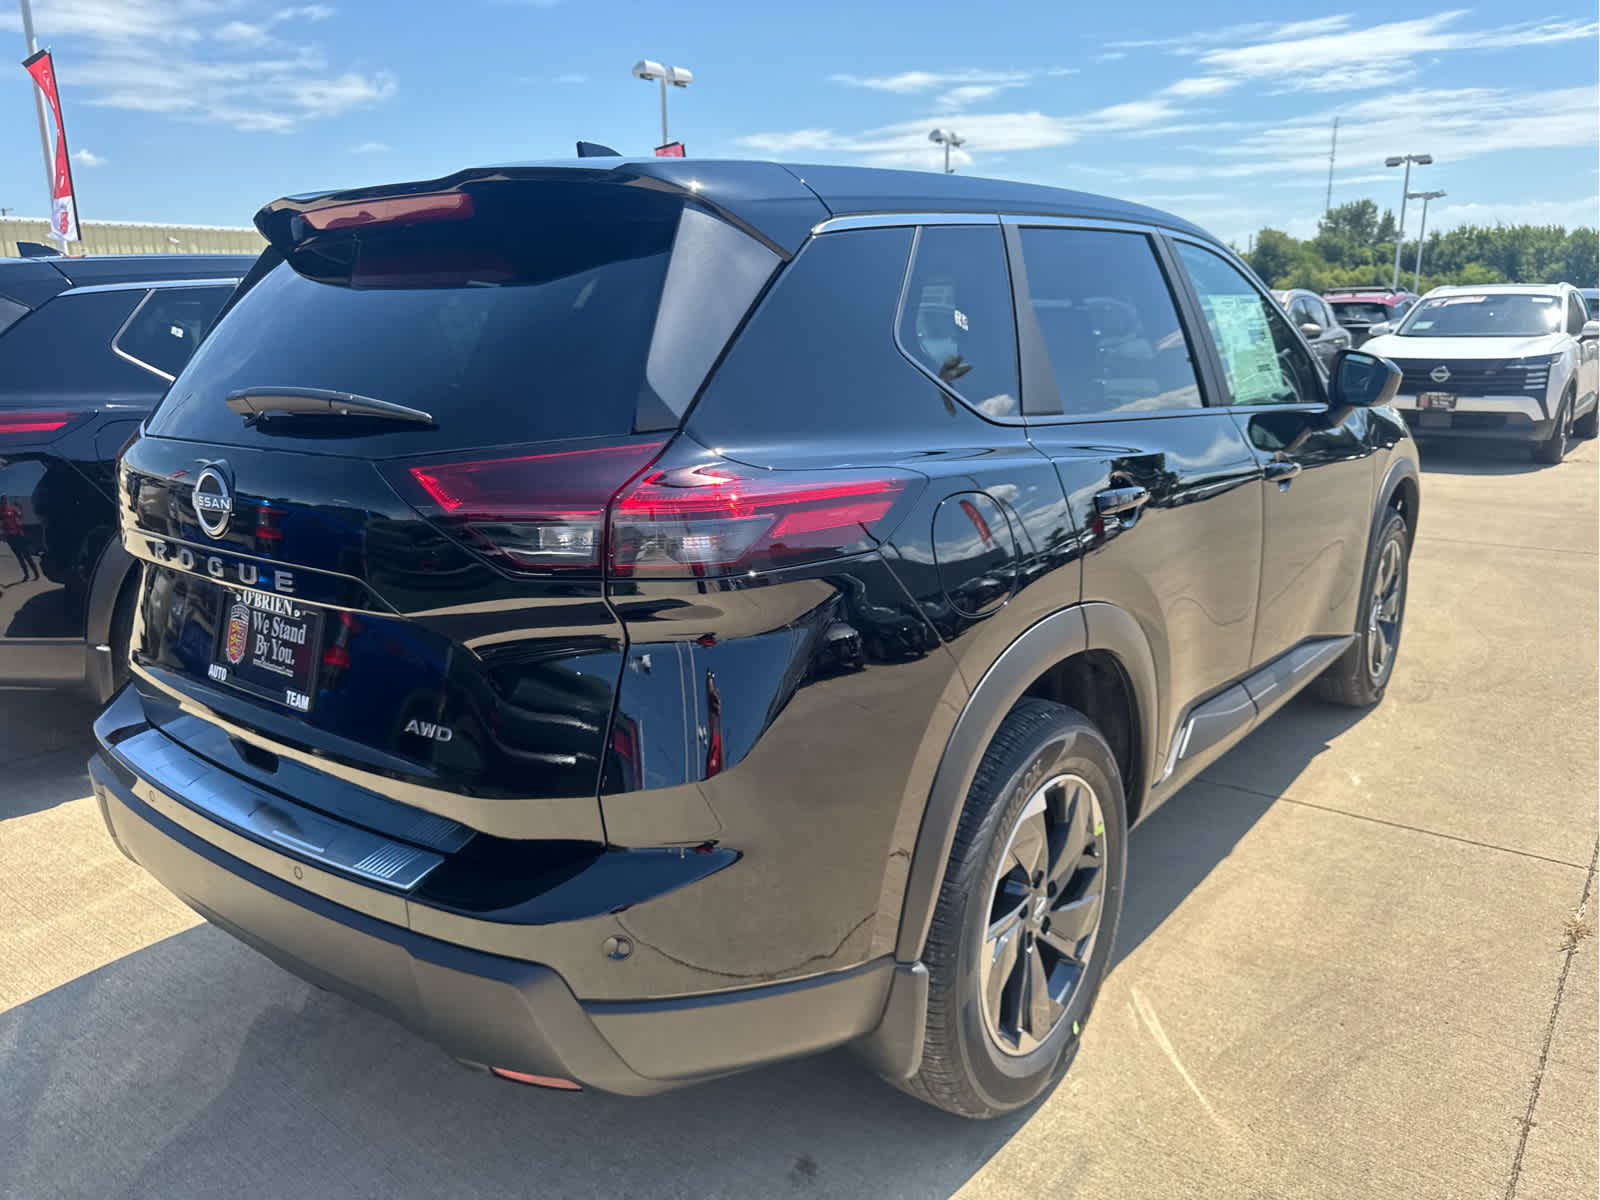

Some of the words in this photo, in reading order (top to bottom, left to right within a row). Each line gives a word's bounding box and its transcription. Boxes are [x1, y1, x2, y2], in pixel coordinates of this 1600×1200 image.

[193, 493, 231, 510] SSAN
[153, 541, 296, 593] ROGUE
[242, 590, 293, 616] O'BRIEN
[253, 611, 270, 634] We
[271, 616, 307, 645] Stand
[254, 634, 270, 660] By
[271, 638, 295, 665] You.
[207, 663, 228, 681] AUTO
[285, 690, 310, 711] TEAM
[403, 719, 453, 742] AWD
